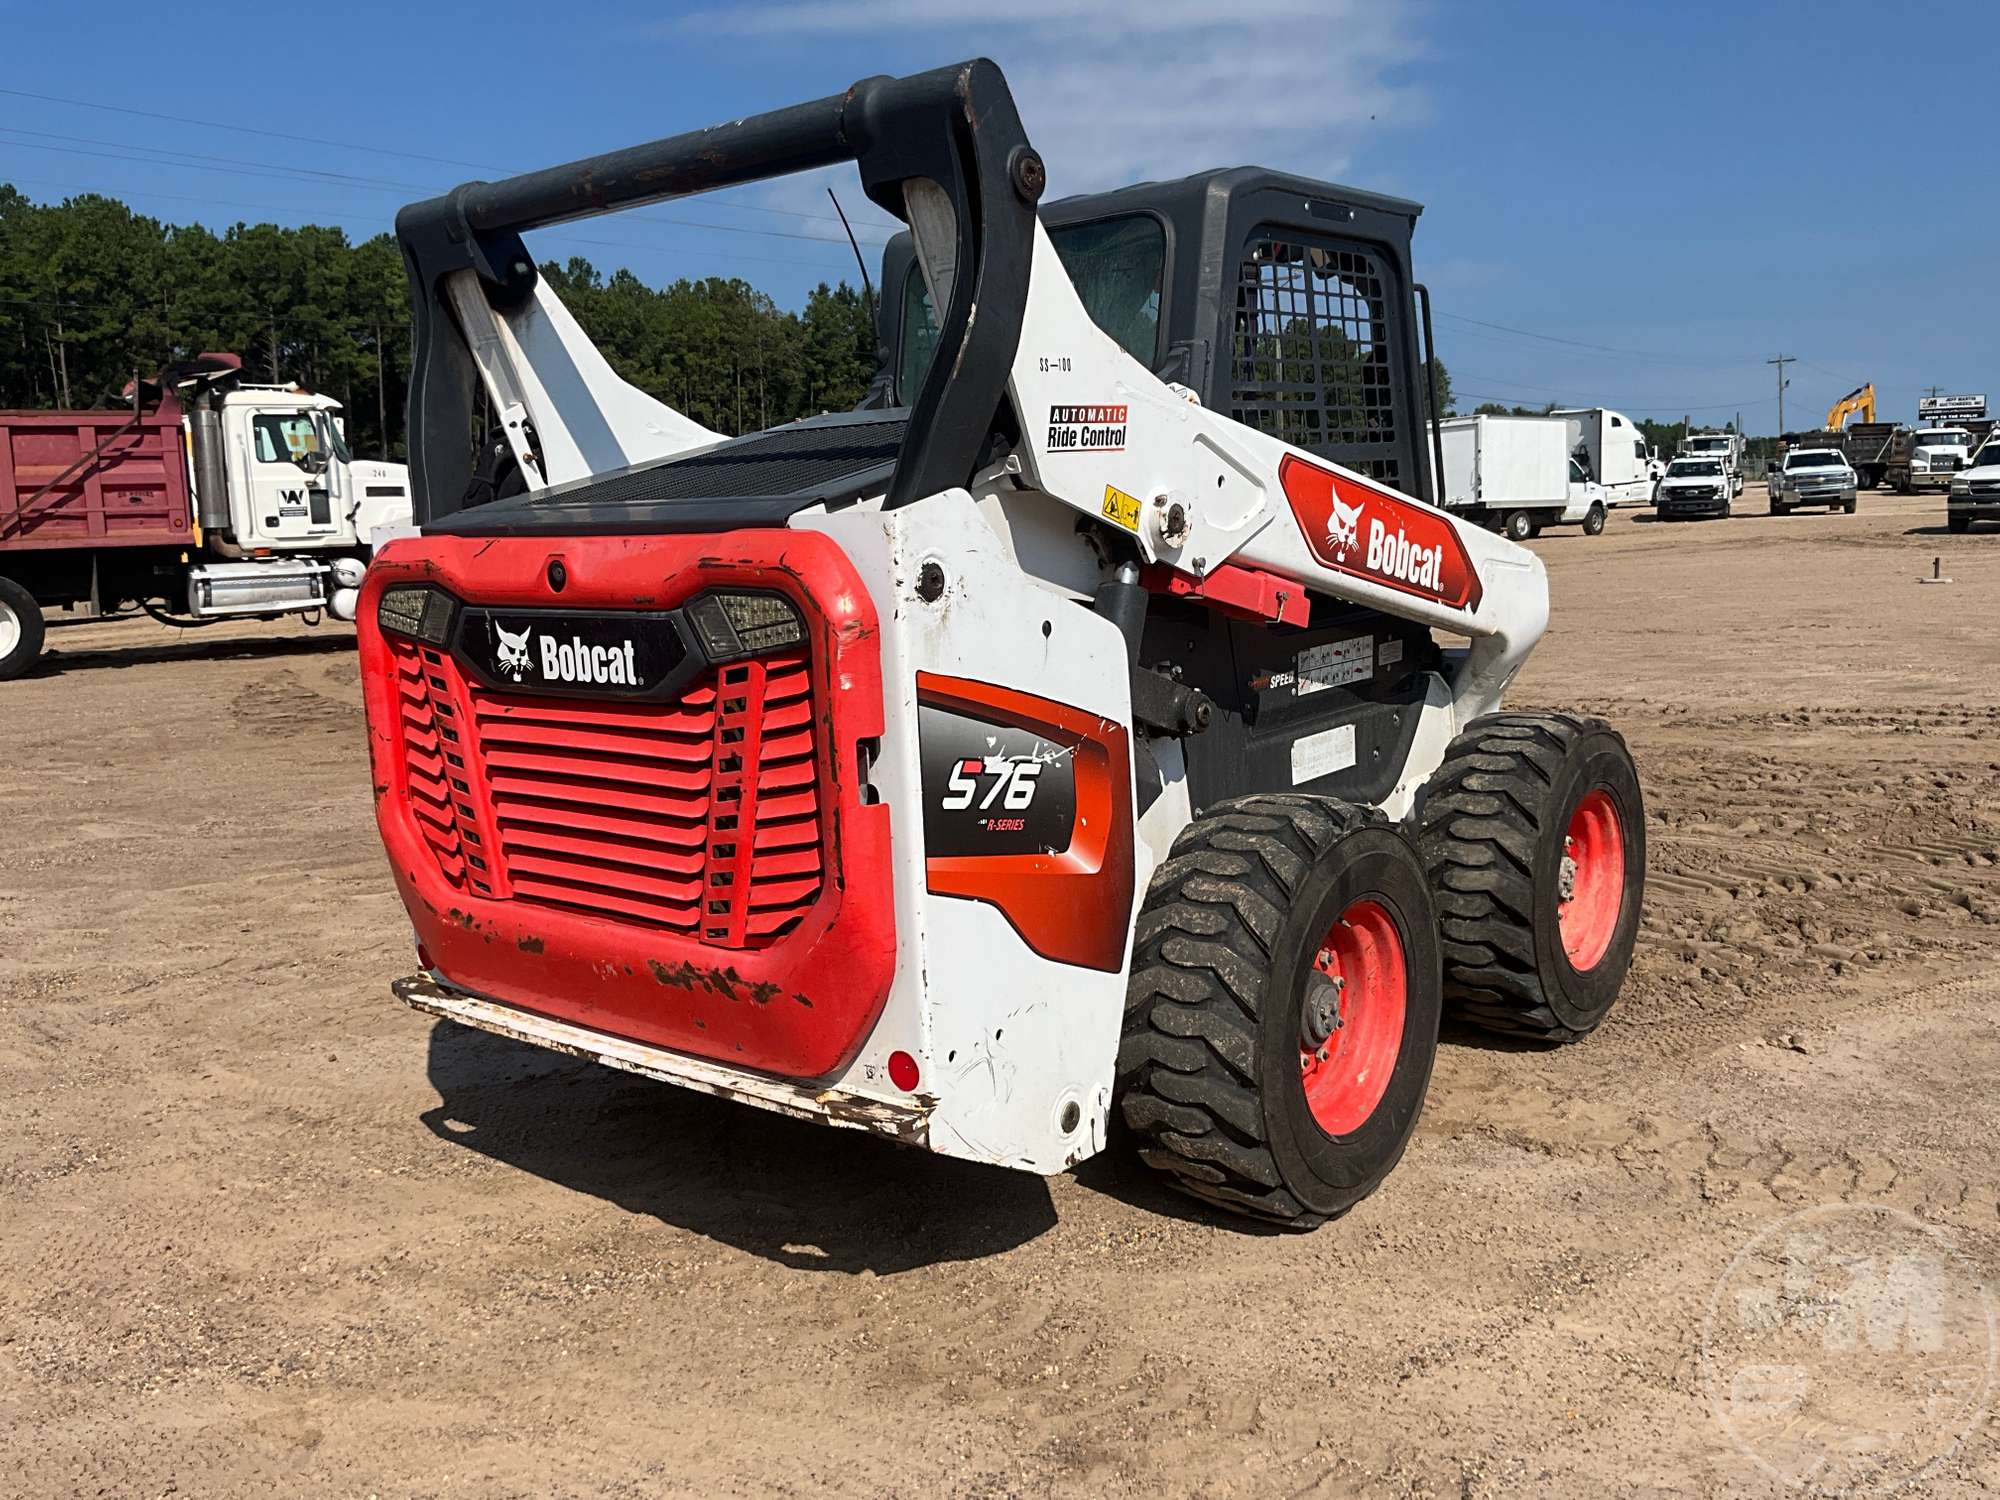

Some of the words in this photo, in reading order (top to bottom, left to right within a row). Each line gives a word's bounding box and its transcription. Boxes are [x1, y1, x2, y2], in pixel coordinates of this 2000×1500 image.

[1052, 407, 1126, 422] AUTOMATIC
[1047, 426, 1078, 448] Ride
[1081, 425, 1127, 447] Control
[1366, 518, 1443, 592] Bobcat
[539, 635, 637, 686] Bobcat
[941, 758, 1043, 810] S76
[987, 818, 1025, 832] R-SERIES
